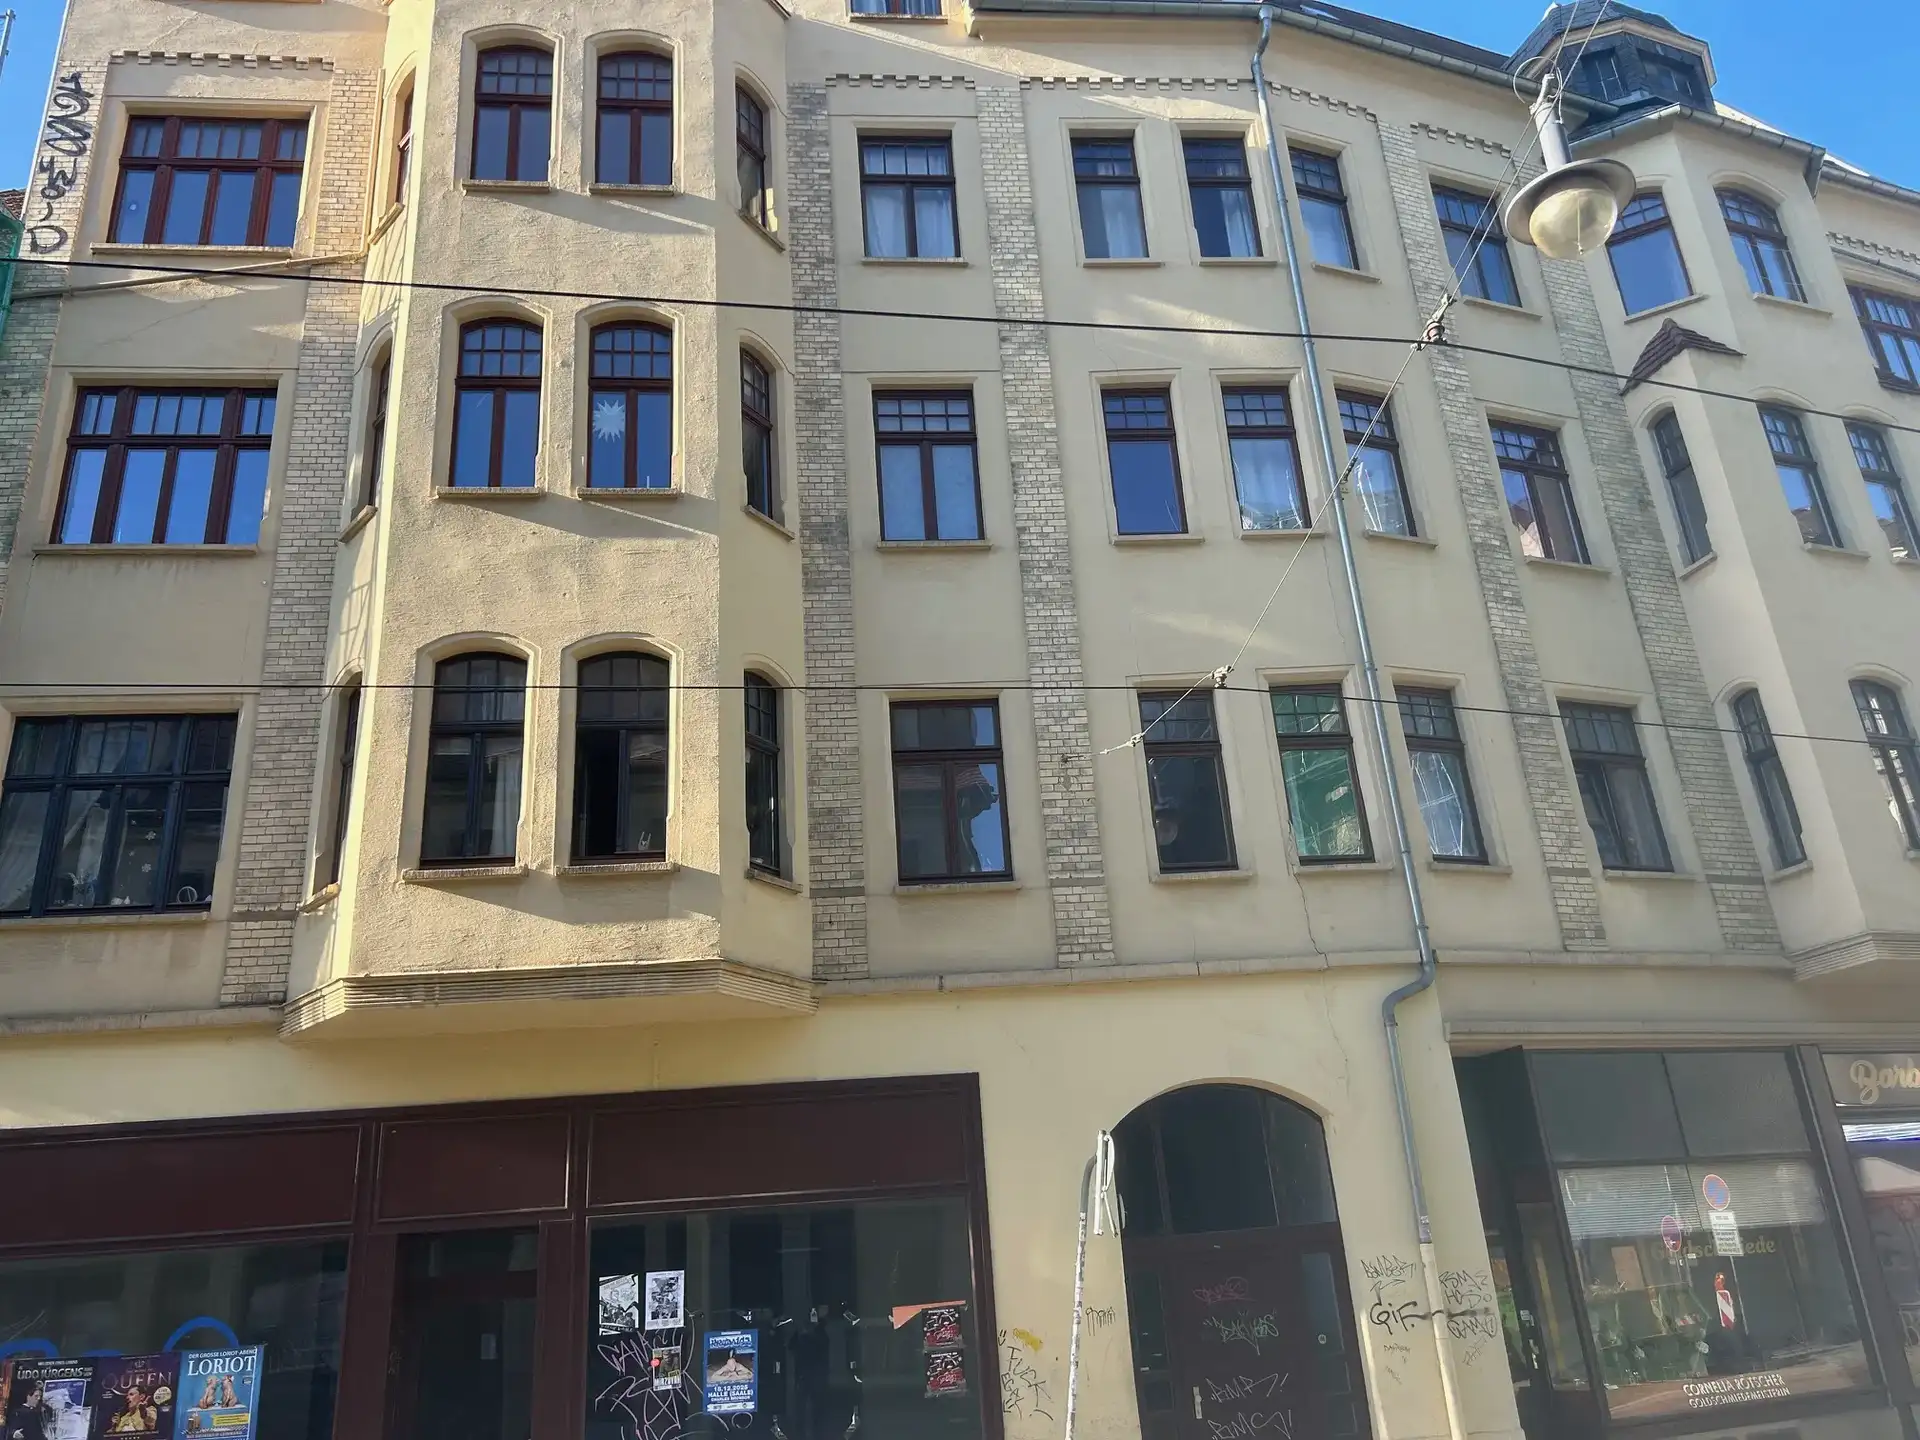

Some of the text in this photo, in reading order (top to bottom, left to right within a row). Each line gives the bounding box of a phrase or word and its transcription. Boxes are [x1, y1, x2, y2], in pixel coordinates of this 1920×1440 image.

[17, 1369, 39, 1380] UDO
[40, 1366, 84, 1379] JÜRGENS
[187, 1355, 256, 1376] LORIOT
[101, 1371, 173, 1396] QUEEN
[1683, 1374, 1786, 1396] CORNELIA RÖTSCHER
[1688, 1387, 1791, 1409] GOLDSCHMIEDEMEISTERIN
